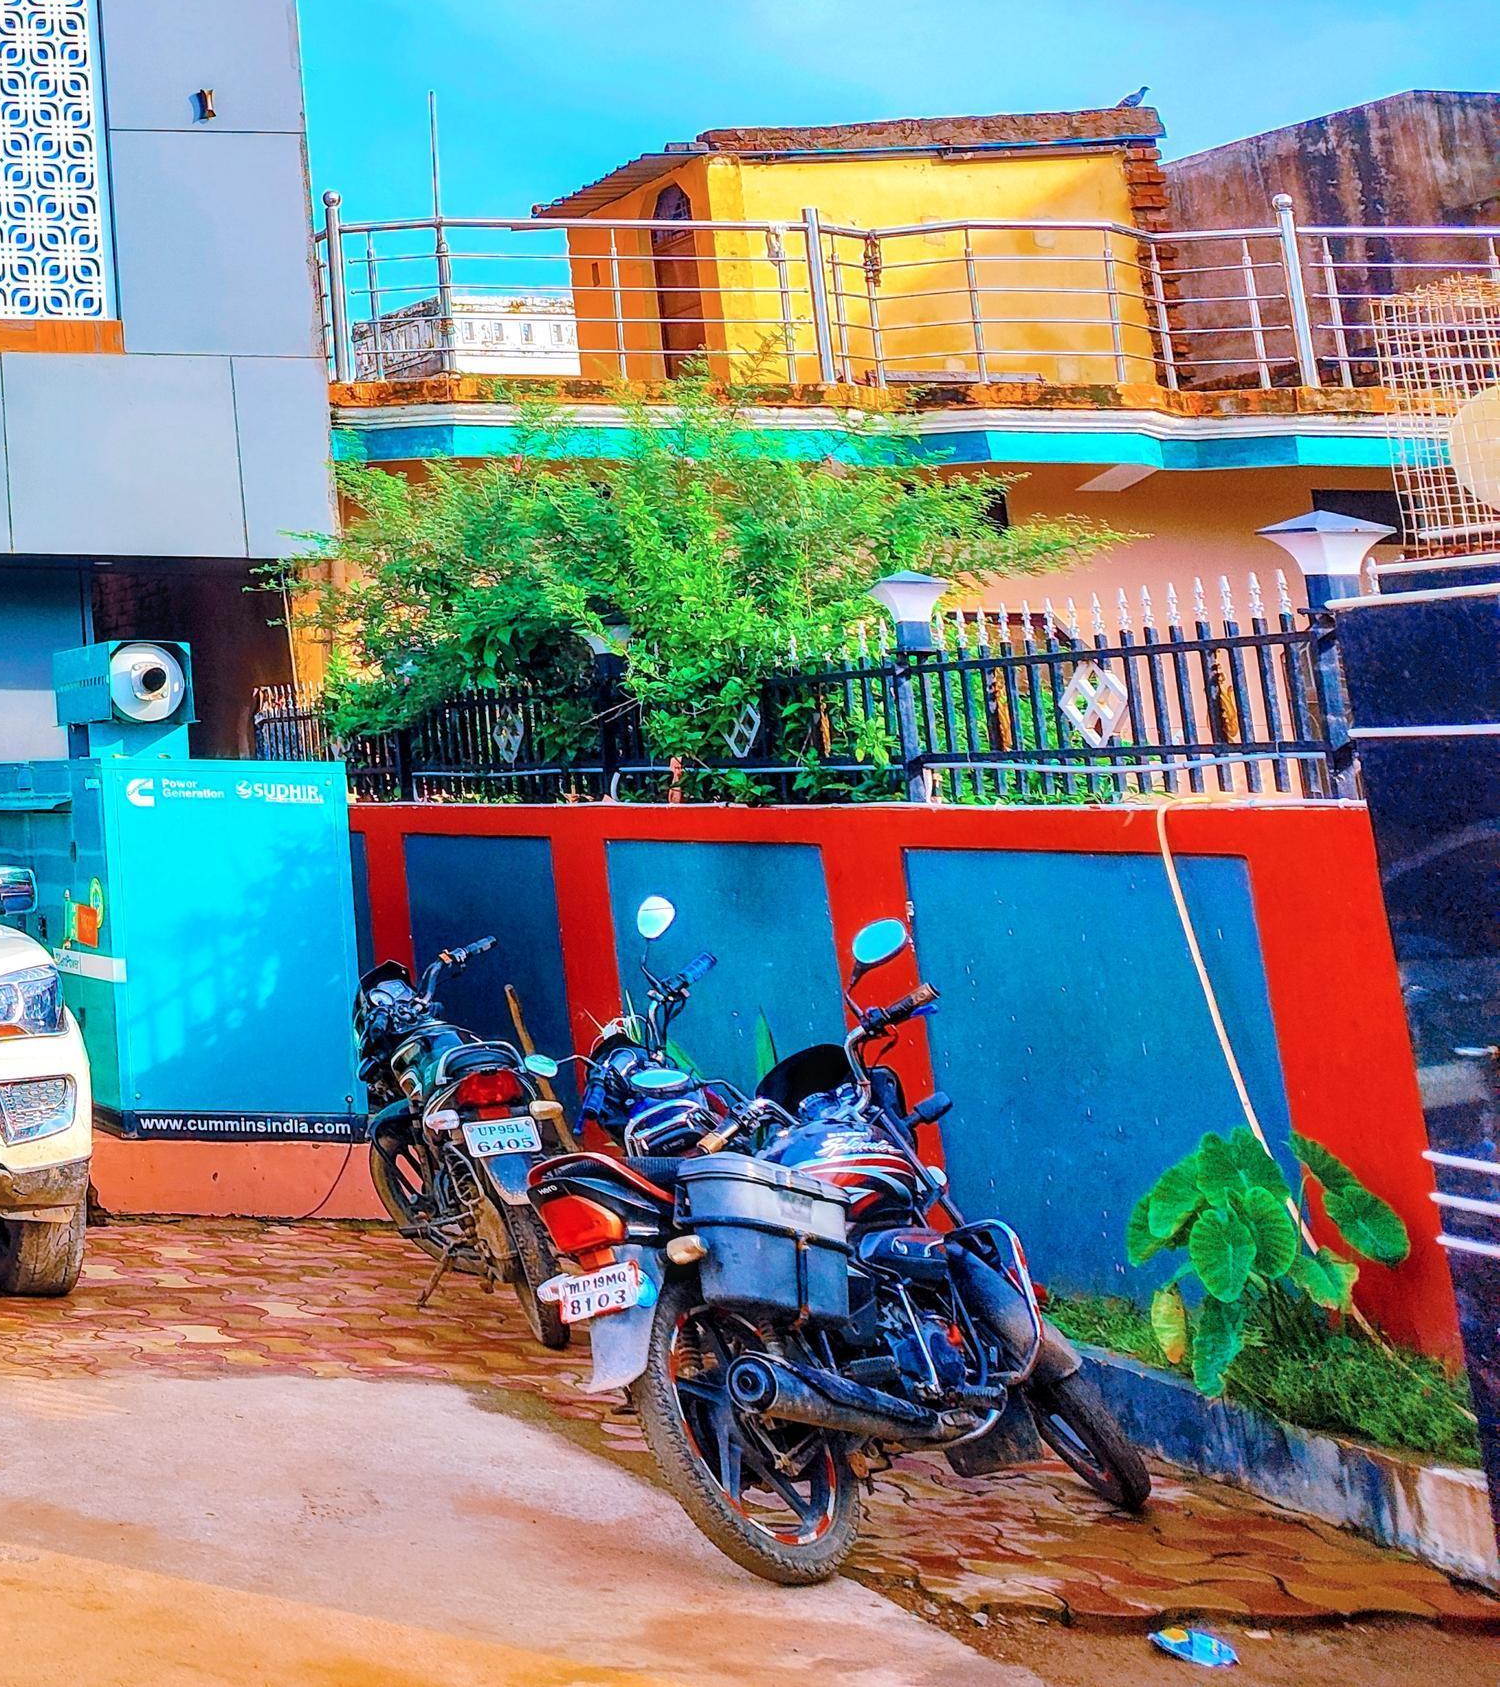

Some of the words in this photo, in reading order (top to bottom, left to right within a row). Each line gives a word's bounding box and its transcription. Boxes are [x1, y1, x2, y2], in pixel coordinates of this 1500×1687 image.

[161, 778, 198, 789] Power
[162, 788, 224, 799] Generation
[140, 1116, 351, 1135] www.cumminsindia.com
[477, 1137, 535, 1152] 6405
[570, 1289, 627, 1316] 8103
